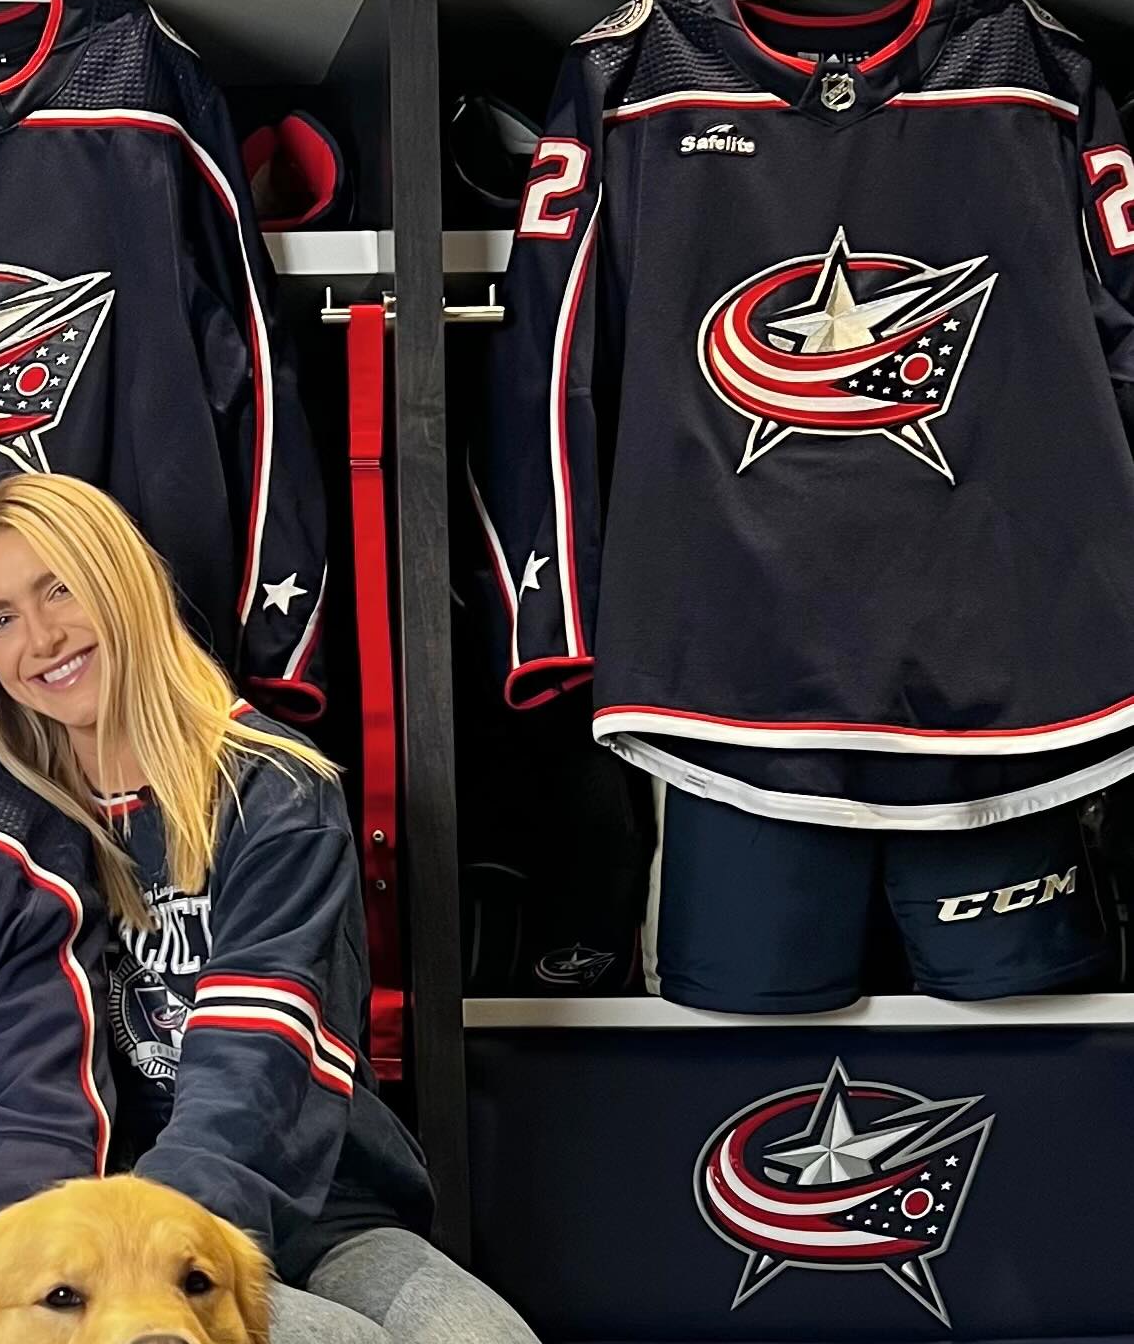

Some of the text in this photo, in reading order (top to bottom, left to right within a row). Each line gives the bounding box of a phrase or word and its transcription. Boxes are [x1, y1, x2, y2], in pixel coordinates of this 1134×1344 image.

[680, 134, 755, 154] Safelite
[516, 136, 592, 240] 2
[936, 864, 1078, 922] CCM
